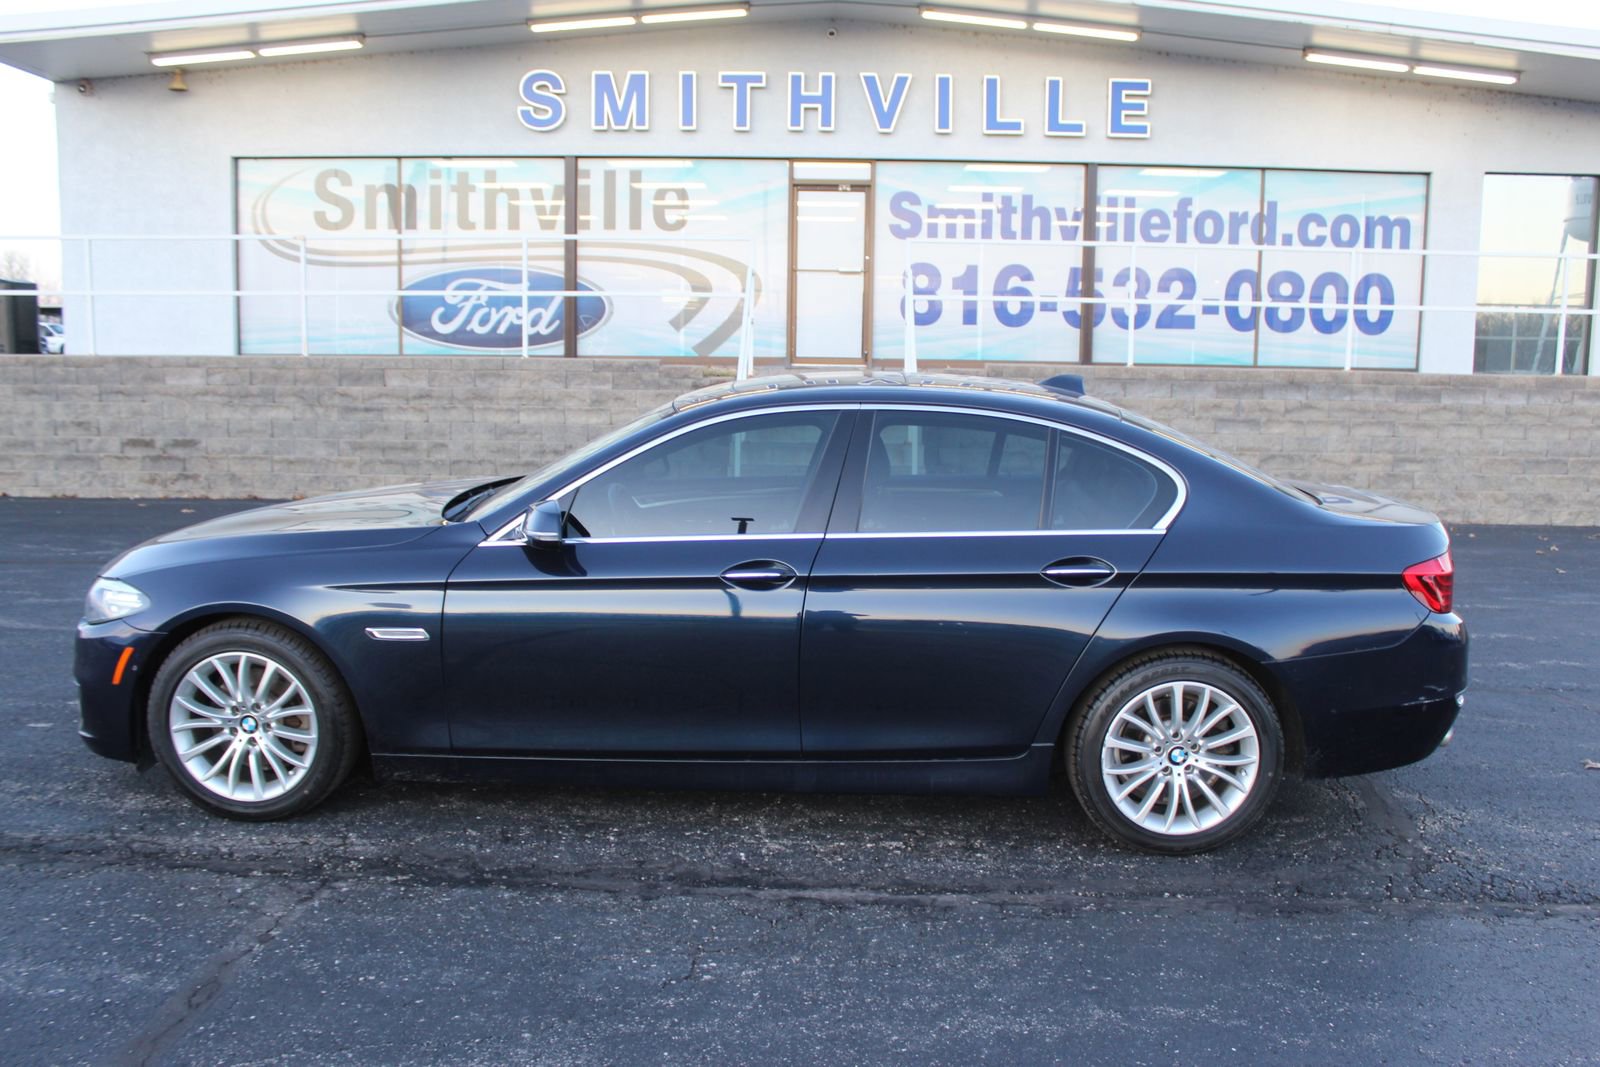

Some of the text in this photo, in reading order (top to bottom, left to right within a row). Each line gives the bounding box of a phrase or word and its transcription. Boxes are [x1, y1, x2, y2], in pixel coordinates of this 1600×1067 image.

[517, 68, 1153, 140] SMITHVILLE
[313, 168, 690, 232] Smithville
[889, 190, 1412, 250] Smithvlleford.com
[430, 276, 564, 337] Ford
[900, 261, 1396, 337] 816-532-0800
